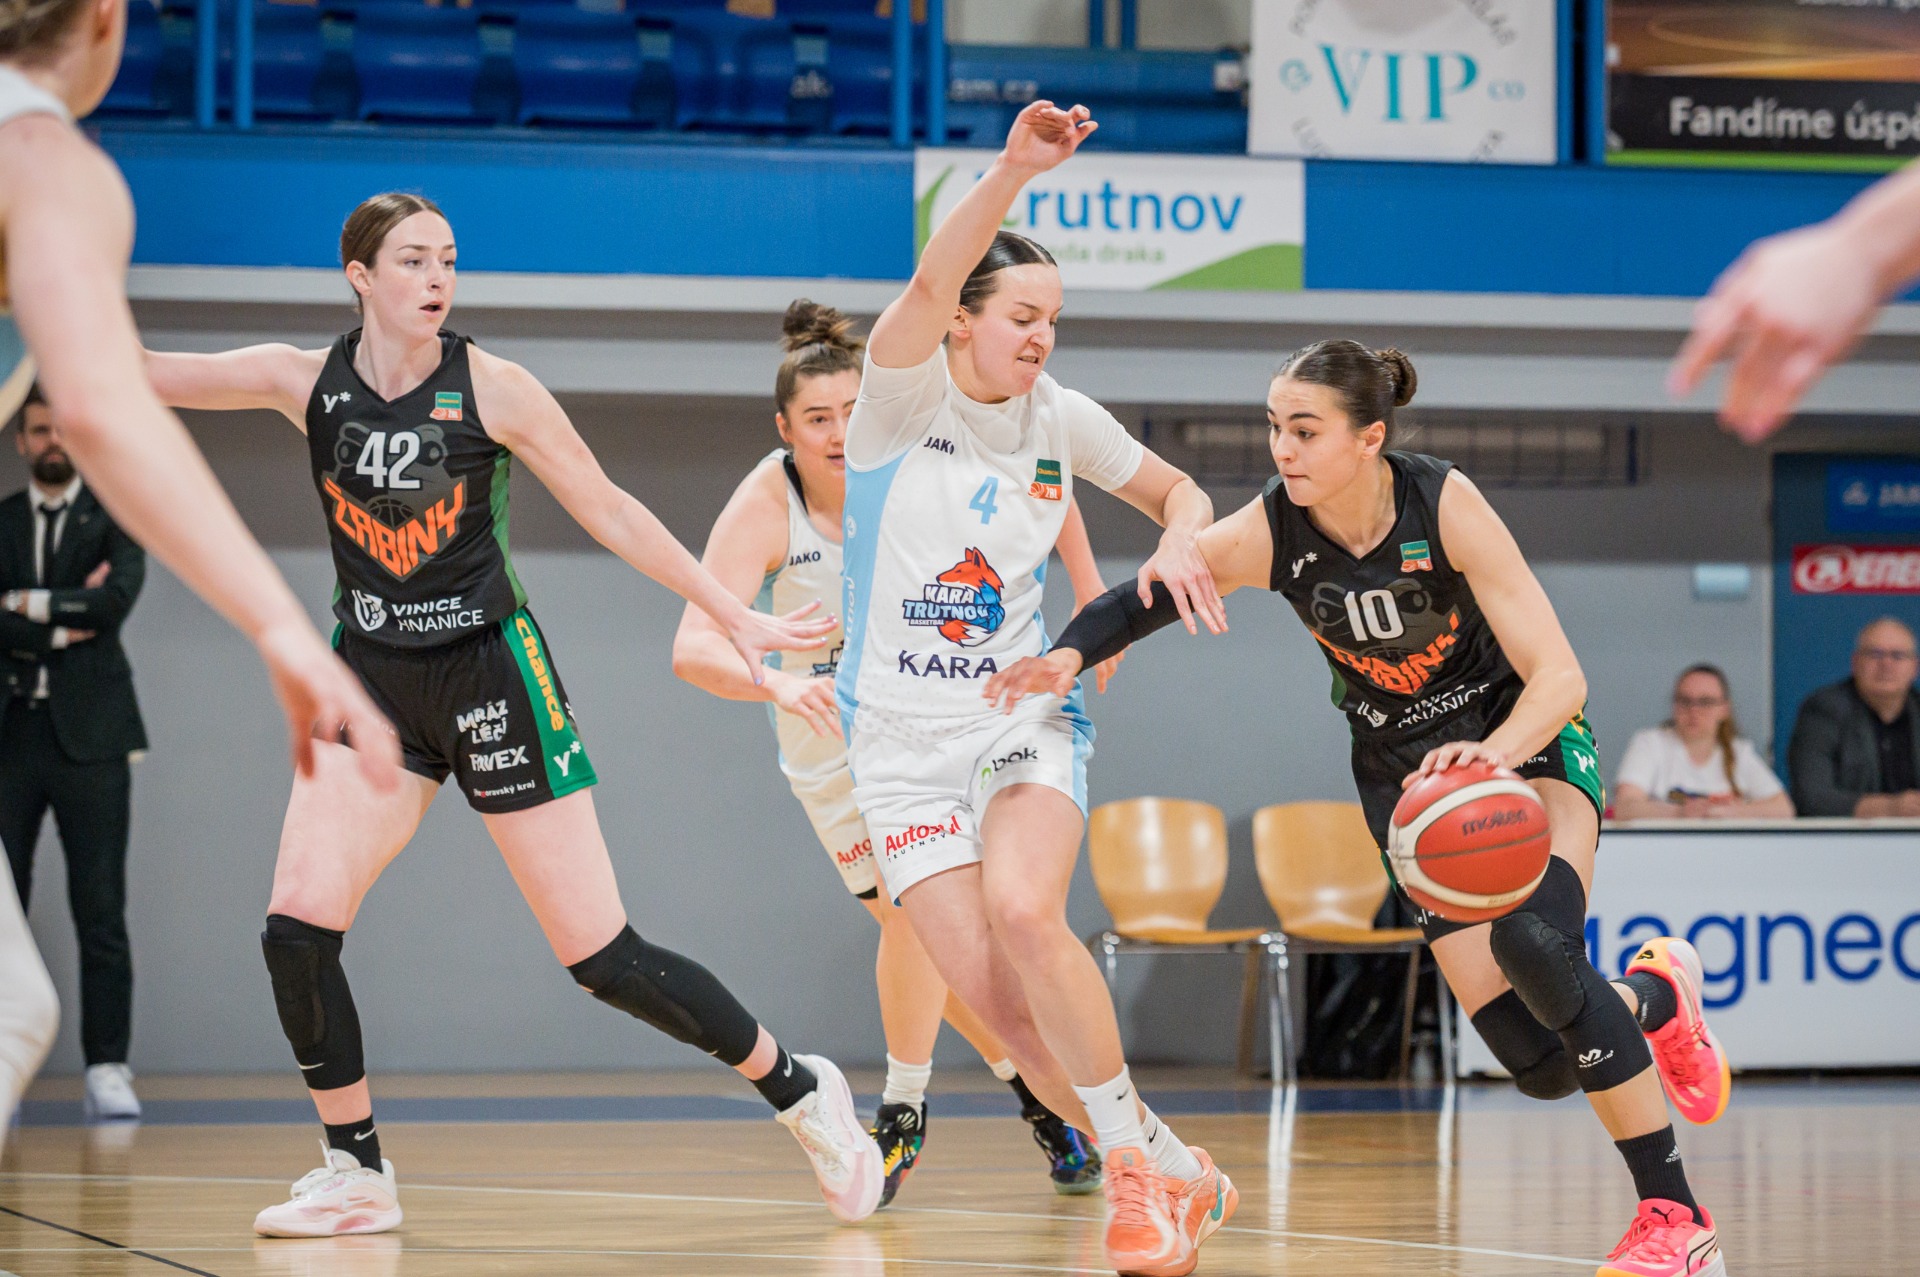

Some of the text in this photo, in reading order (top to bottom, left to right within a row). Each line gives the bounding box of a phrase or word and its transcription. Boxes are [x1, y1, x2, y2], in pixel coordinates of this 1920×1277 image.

[1317, 43, 1478, 122] VIP
[1669, 96, 1836, 139] Fandíme
[1000, 178, 1243, 232] rutnov
[356, 431, 421, 490] 42
[969, 476, 1000, 526] 4
[789, 551, 821, 566] JAKO
[392, 597, 462, 616] VINICE
[904, 601, 989, 621] TRUTNOV
[925, 585, 975, 604] KARA
[1344, 589, 1405, 642] 10
[899, 650, 998, 679] KARA
[456, 699, 509, 733] MRÁZ
[836, 837, 872, 866] Auto
